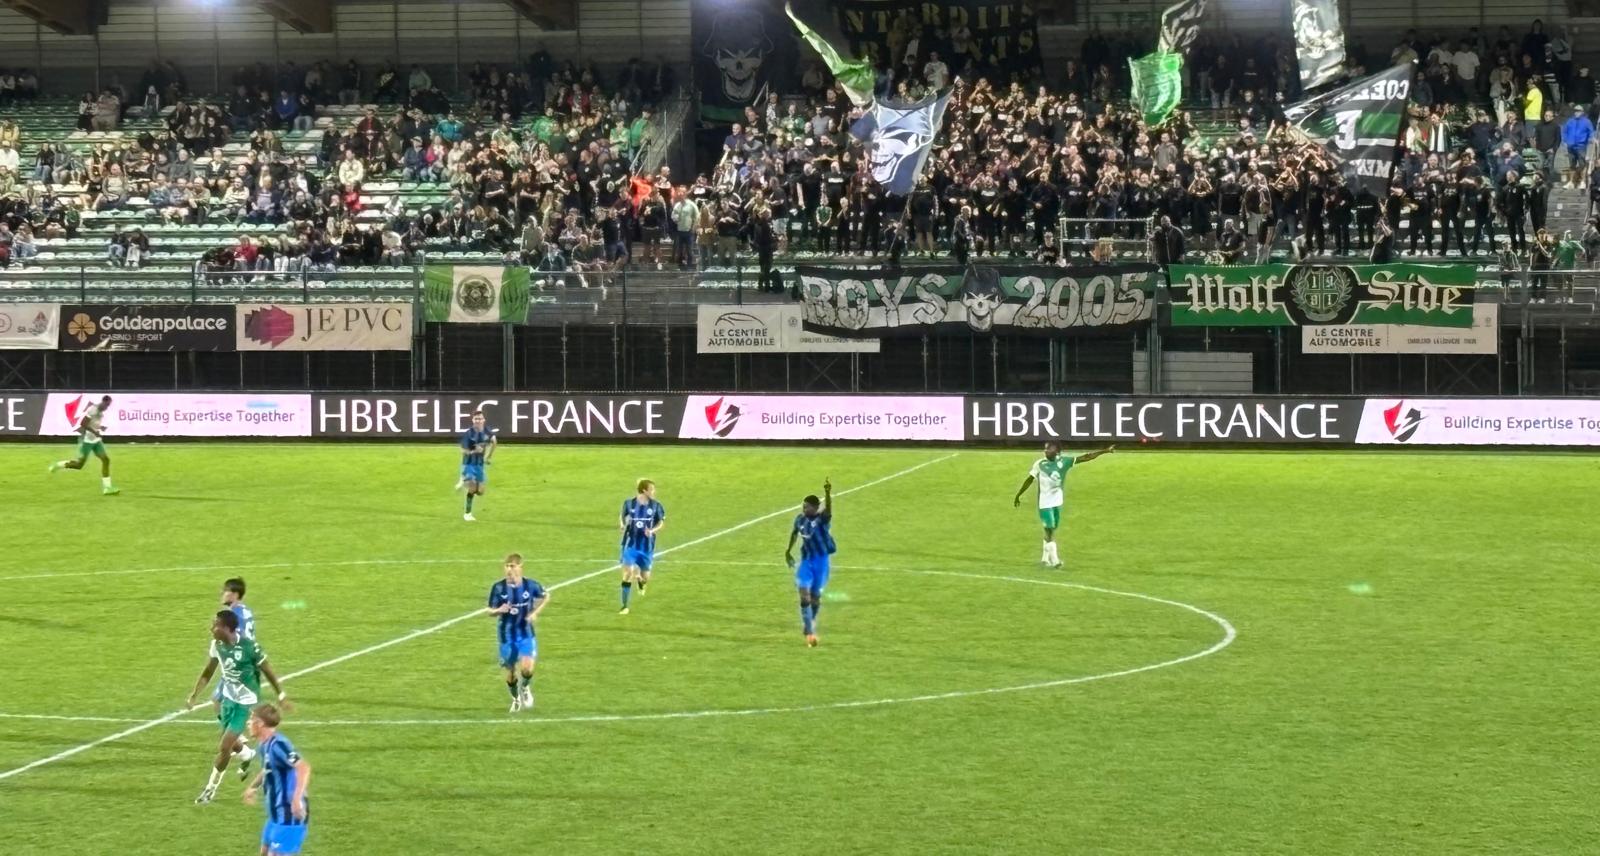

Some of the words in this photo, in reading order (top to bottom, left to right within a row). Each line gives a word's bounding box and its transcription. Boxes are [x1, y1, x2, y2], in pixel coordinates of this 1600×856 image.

[800, 273, 948, 330] BOYS
[1013, 272, 1148, 329] 2005
[1185, 273, 1278, 313] Wolf
[1366, 271, 1461, 315] Side
[99, 315, 227, 333] Goldenpalace
[301, 308, 335, 342] JE
[344, 307, 402, 332] PVC
[713, 328, 725, 337] LE
[728, 328, 768, 337] CENTRE
[1315, 328, 1327, 337] LE
[1330, 328, 1374, 337] CENTRE
[708, 337, 775, 346] AUTOMOBILE
[1309, 338, 1382, 347] AUTOMOBILE
[0, 398, 26, 431] E
[119, 409, 170, 424] Building
[174, 410, 233, 424] Expertise
[237, 410, 295, 424] Together
[319, 399, 402, 433] HBR
[512, 400, 665, 434] FRANCE
[761, 412, 815, 427] Building
[820, 412, 881, 427] Expertise
[885, 412, 947, 427] Together
[973, 402, 1060, 437] HBR
[1071, 402, 1162, 438] ELEC
[1177, 403, 1340, 439] FRANCE
[1444, 416, 1502, 431] Building
[1507, 416, 1573, 431] Expertise
